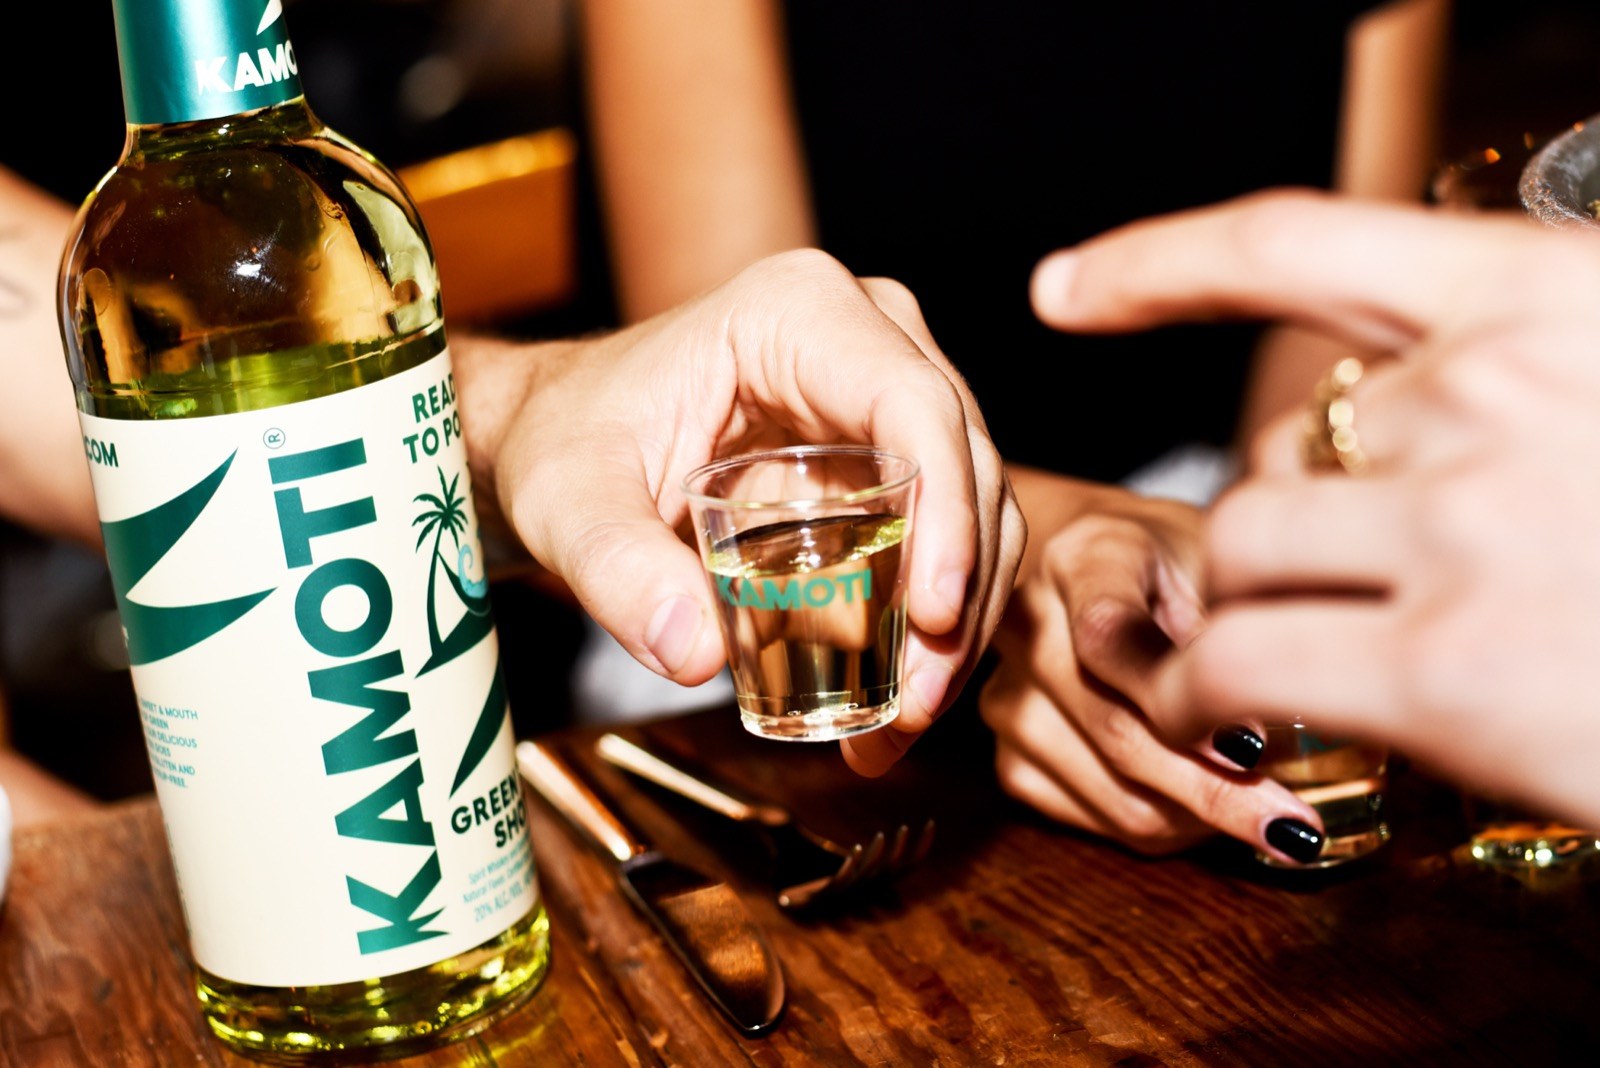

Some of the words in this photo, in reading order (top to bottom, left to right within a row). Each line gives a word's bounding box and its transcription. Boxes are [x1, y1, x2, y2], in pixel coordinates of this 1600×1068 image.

[403, 426, 439, 464] TO
[716, 568, 872, 610] KAMOTI
[165, 707, 198, 720] MOUTH
[268, 438, 450, 955] KAMOTI
[157, 731, 197, 748] DELICIOUS
[179, 764, 195, 775] AND
[451, 771, 518, 834] GREEN
